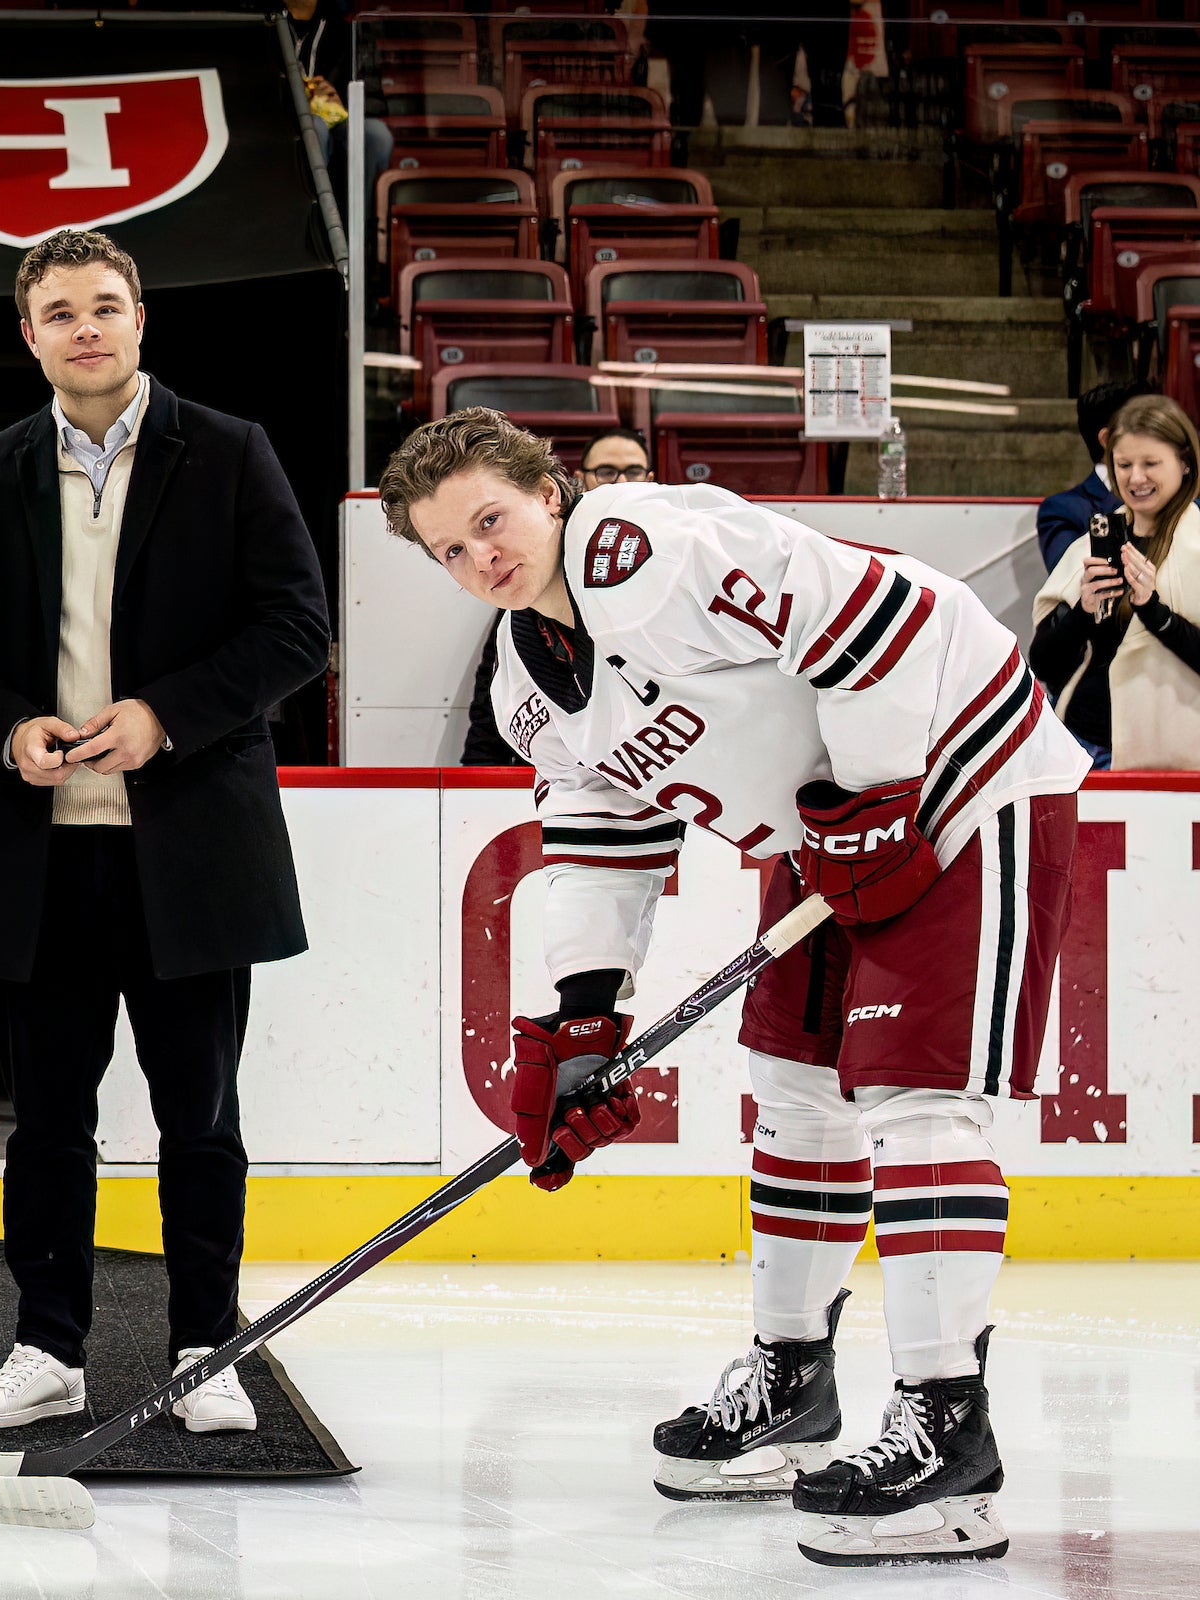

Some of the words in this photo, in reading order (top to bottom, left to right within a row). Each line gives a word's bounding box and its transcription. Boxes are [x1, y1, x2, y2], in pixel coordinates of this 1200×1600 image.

[708, 568, 794, 650] 12
[803, 817, 907, 855] CCM
[569, 1020, 603, 1033] CCM
[846, 1003, 903, 1024] CCM
[129, 1365, 210, 1429] FLYLITE
